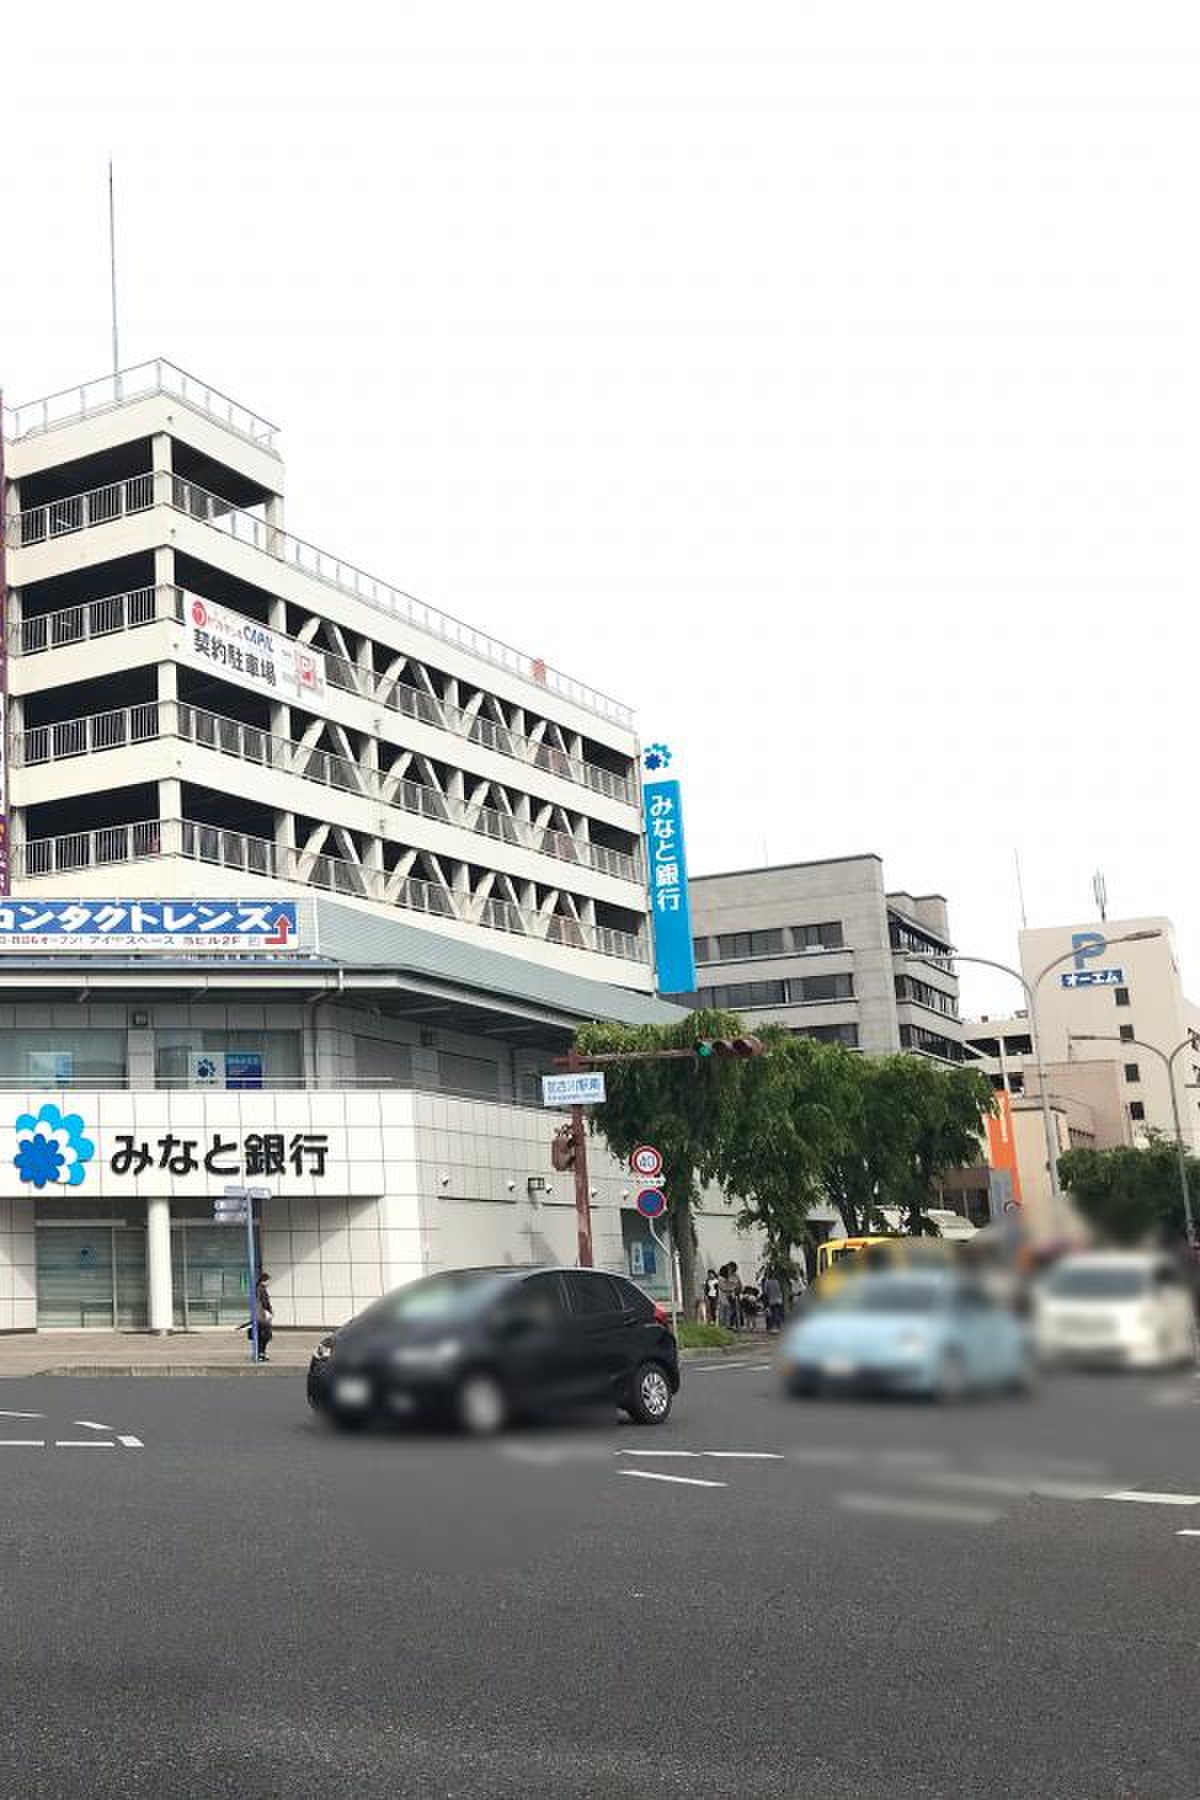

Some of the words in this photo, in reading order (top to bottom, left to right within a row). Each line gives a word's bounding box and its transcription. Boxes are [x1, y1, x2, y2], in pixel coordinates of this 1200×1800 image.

[193, 628, 277, 687] 契約駐車場
[650, 794, 681, 912] みなと銀行
[1071, 932, 1105, 969] P
[111, 1132, 328, 1177] みなと銀行
